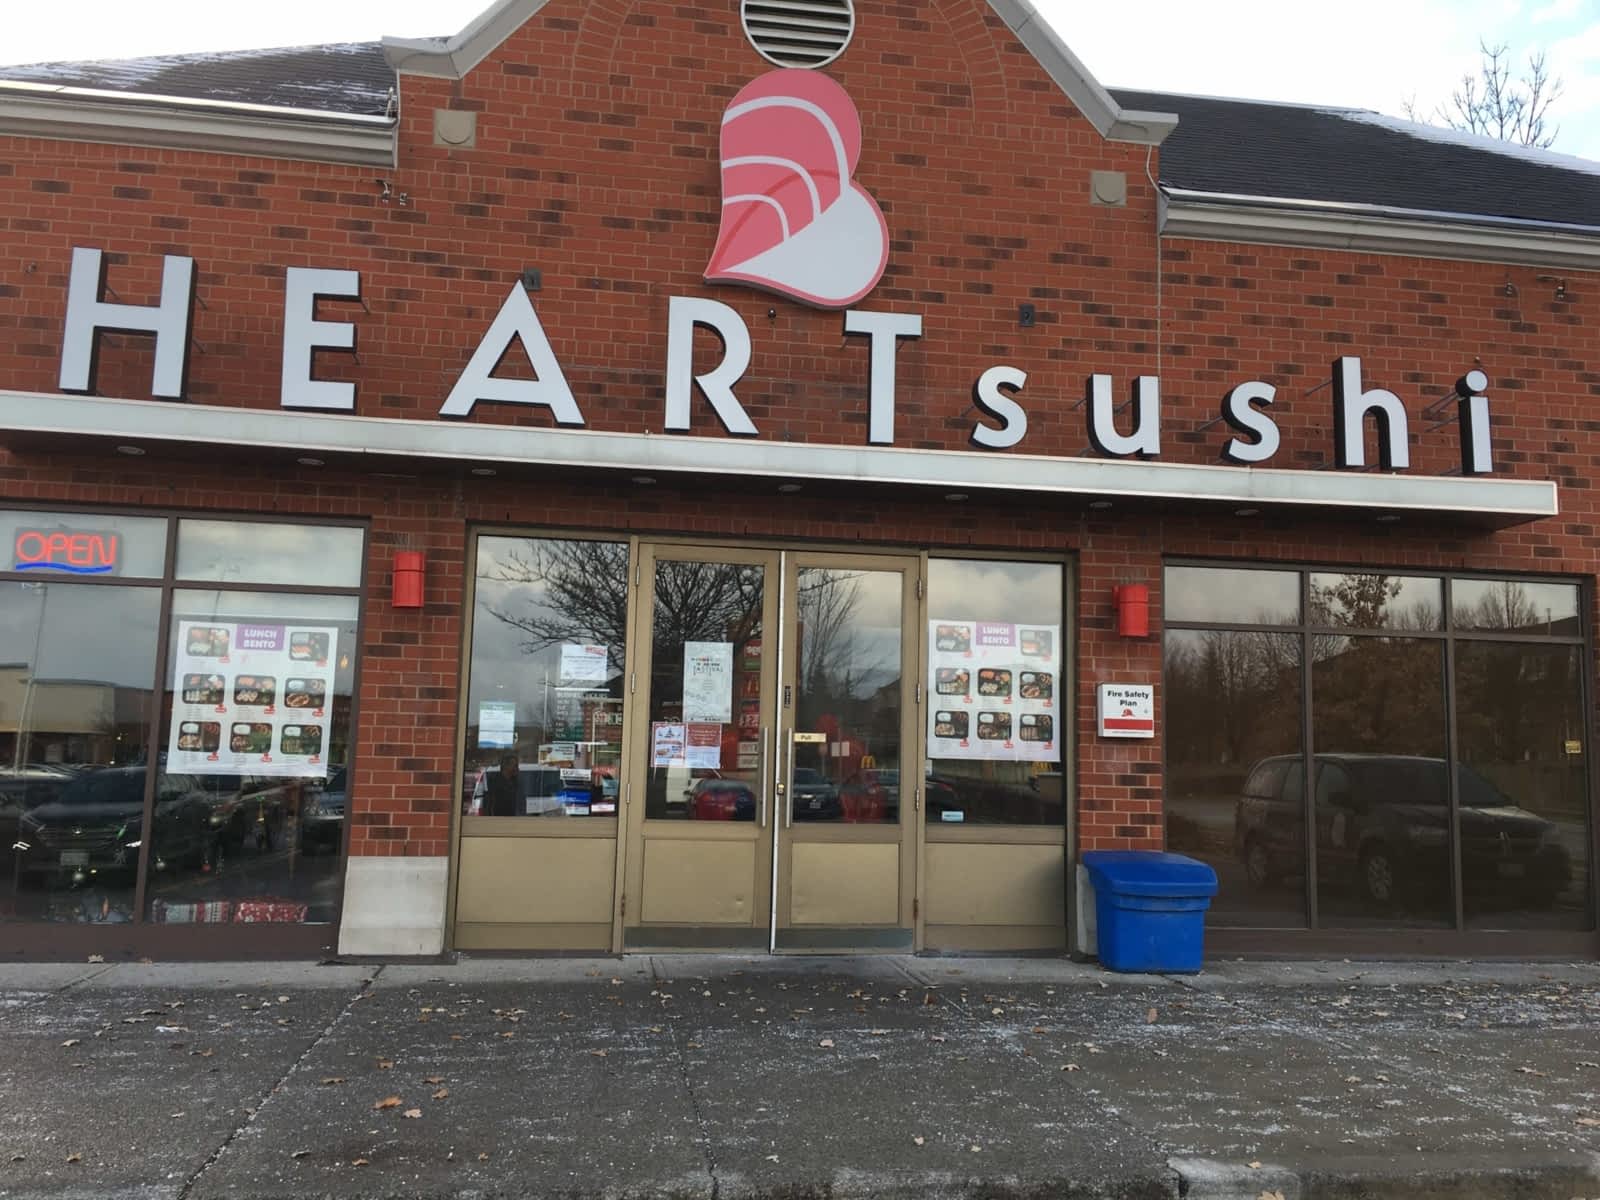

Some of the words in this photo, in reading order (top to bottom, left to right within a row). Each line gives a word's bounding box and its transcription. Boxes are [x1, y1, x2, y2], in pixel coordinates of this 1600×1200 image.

[15, 531, 117, 565] OPEN
[244, 628, 277, 640] LUNCH
[983, 626, 1010, 635] LUNCH
[243, 639, 276, 649] BENTO
[982, 635, 1010, 645] BENTO
[1124, 691, 1149, 699] Safety
